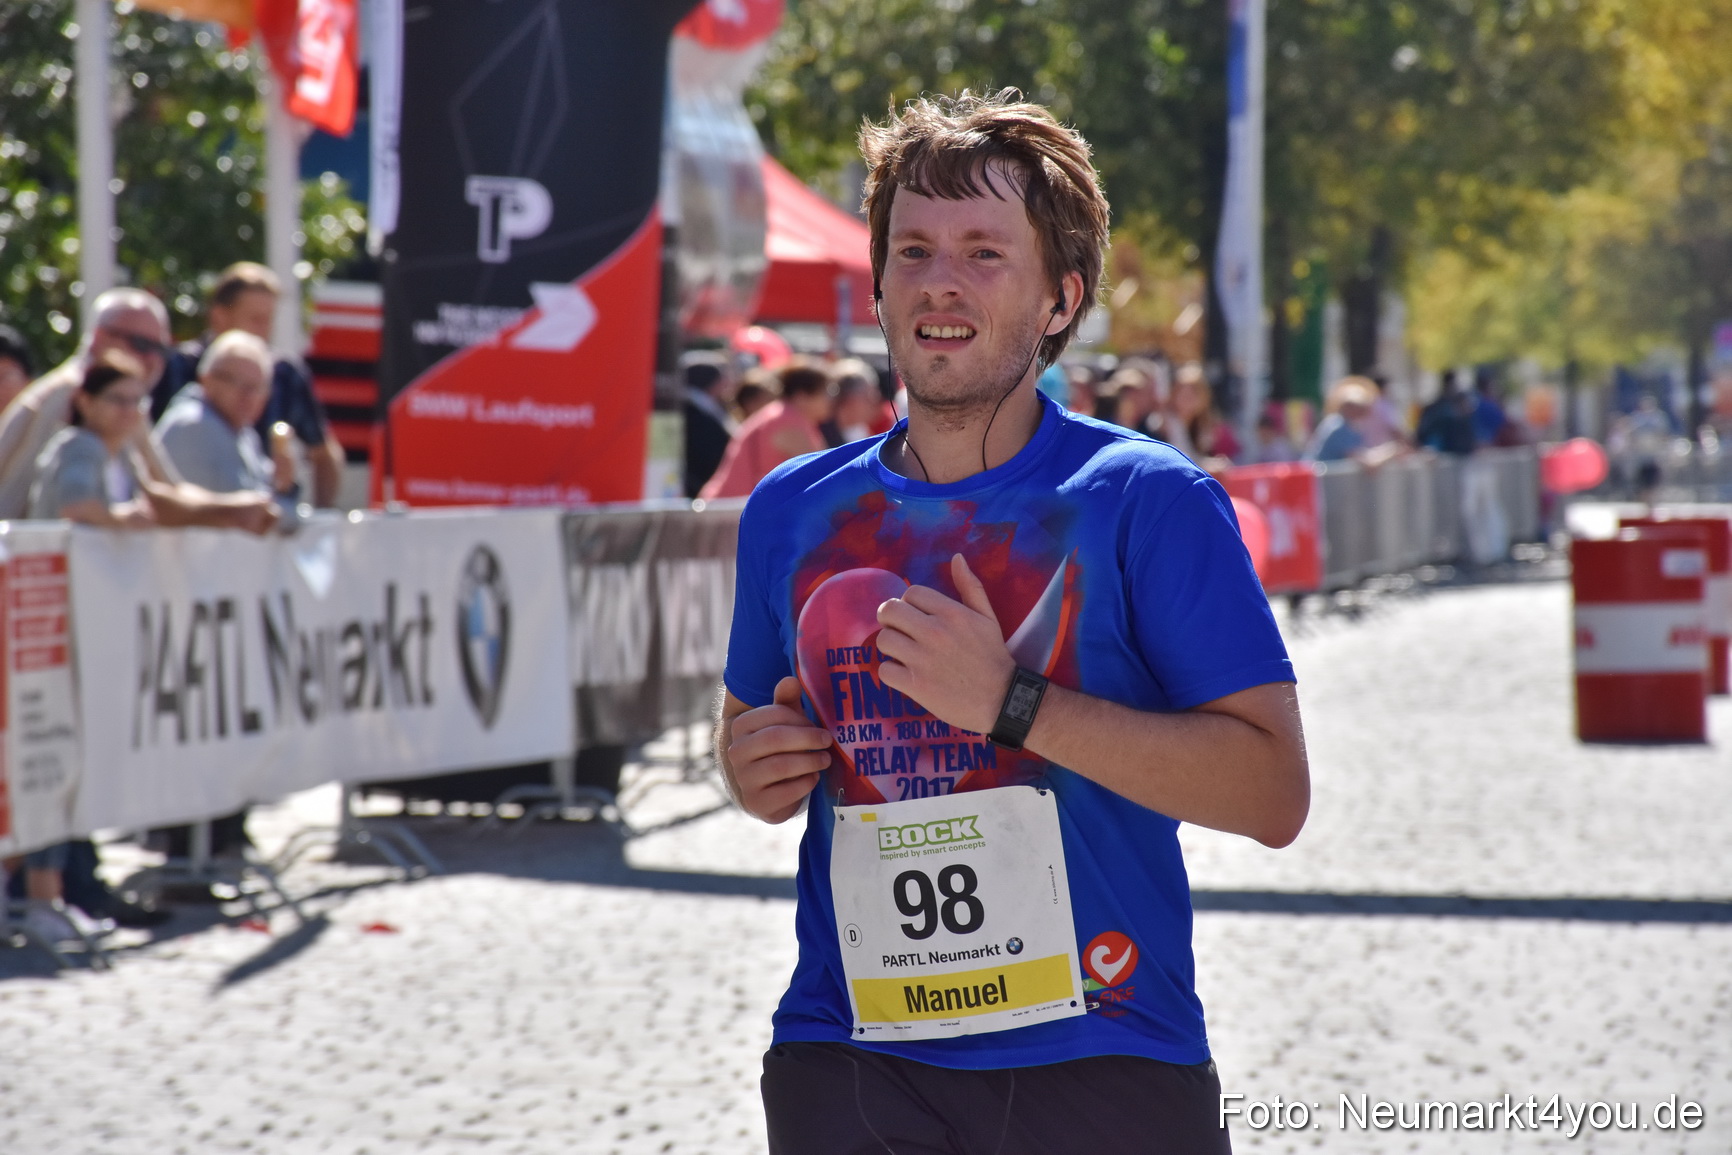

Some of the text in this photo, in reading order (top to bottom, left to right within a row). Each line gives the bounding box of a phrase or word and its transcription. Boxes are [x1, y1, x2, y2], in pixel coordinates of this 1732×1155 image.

[826, 646, 873, 667] DATEV
[836, 724, 857, 743] 3,8
[858, 723, 883, 742] KM
[894, 720, 922, 740] 180
[925, 720, 950, 738] KM
[854, 742, 998, 776] RELAY TEAM
[896, 776, 956, 801] 2017
[878, 815, 984, 851] BOCK
[879, 841, 986, 861] inspired by smart concepts
[893, 864, 985, 940] 98
[882, 944, 1001, 968] PARTL Neumarkt
[903, 974, 1009, 1013] Manuel
